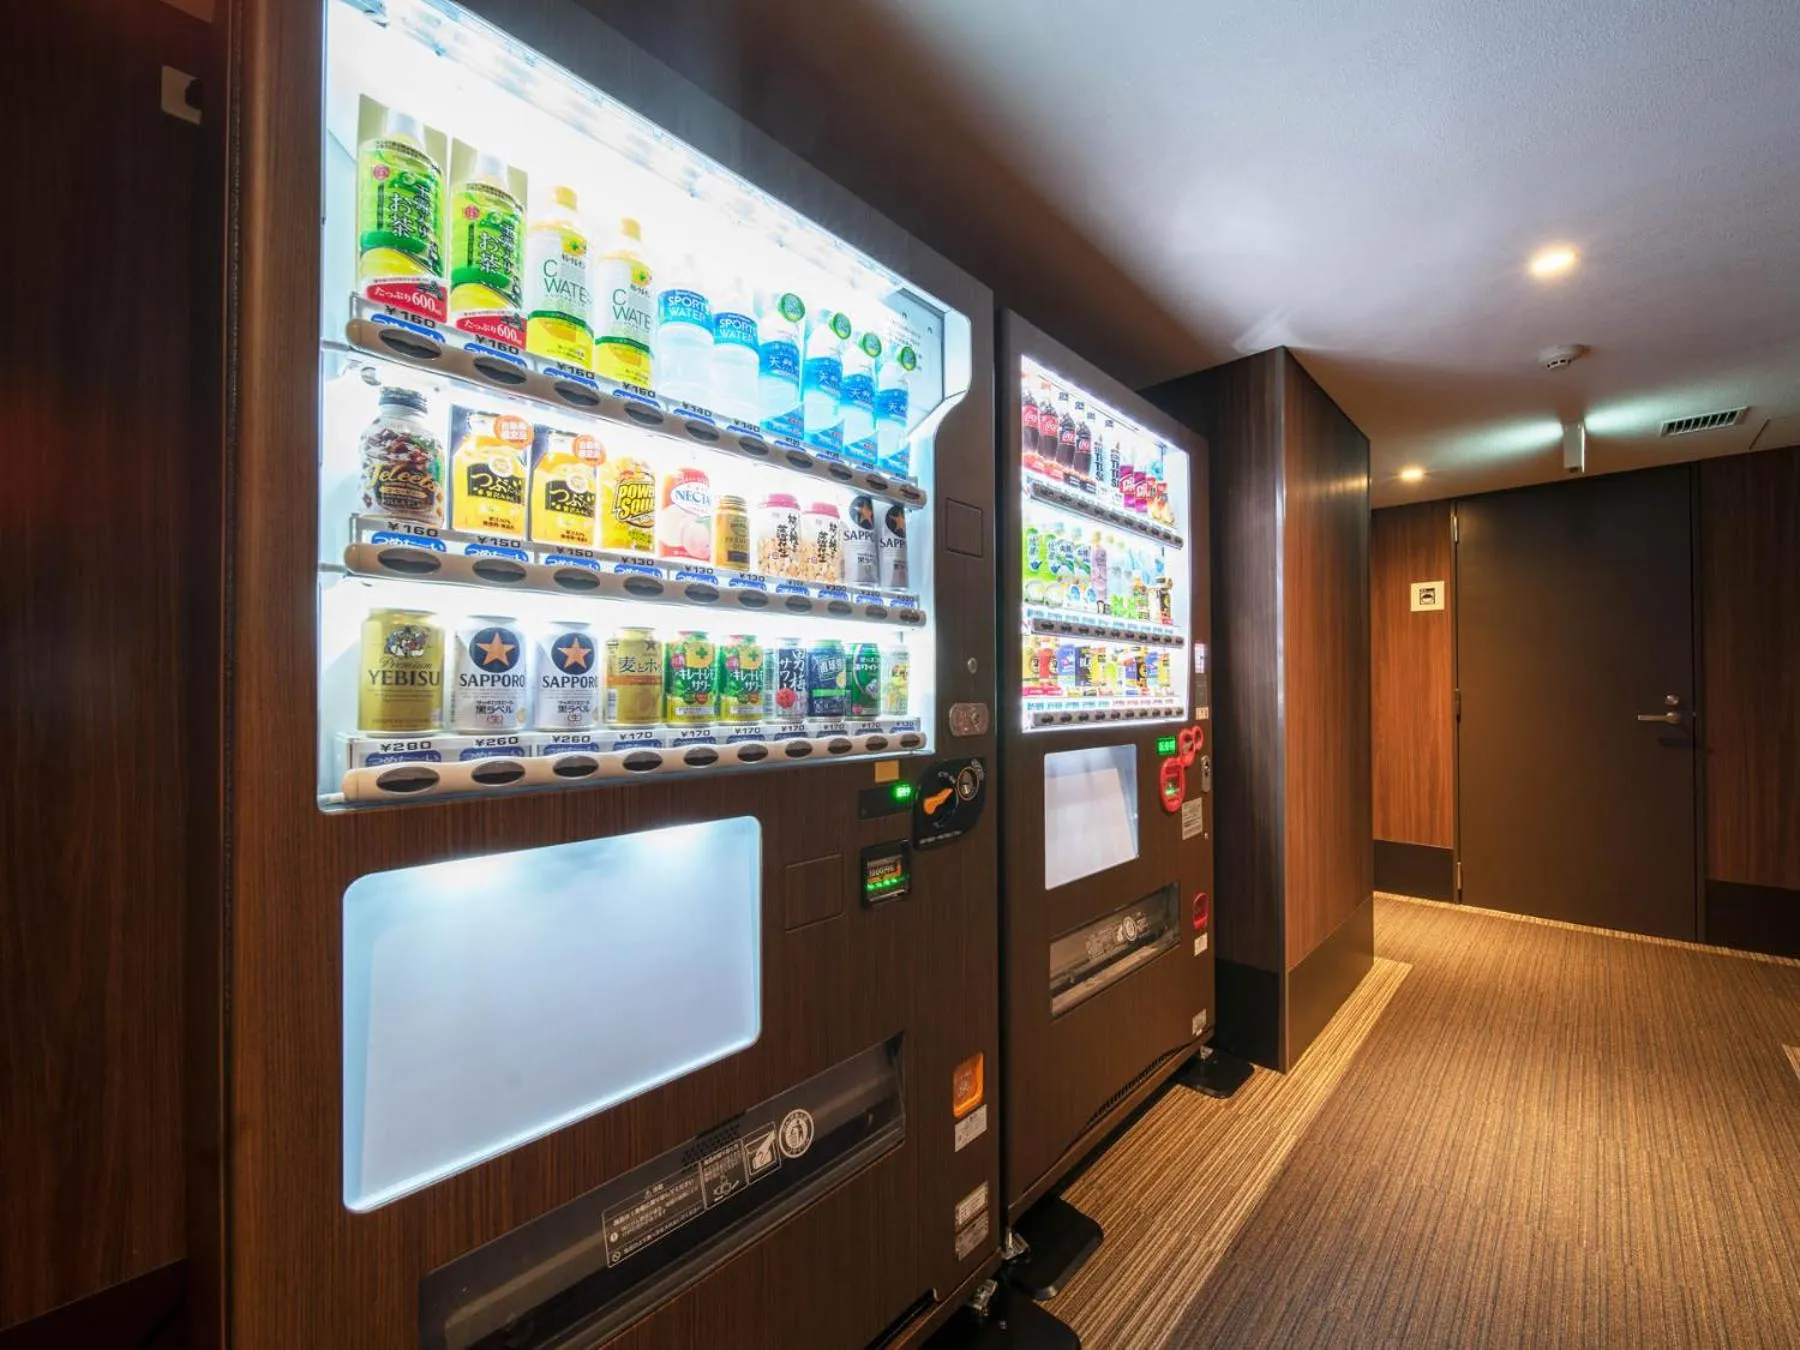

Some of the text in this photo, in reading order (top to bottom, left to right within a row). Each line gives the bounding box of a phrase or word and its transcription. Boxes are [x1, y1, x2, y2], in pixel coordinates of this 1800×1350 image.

[390, 191, 411, 238] お茶
[480, 231, 498, 273] お茶
[543, 259, 557, 278] C
[612, 289, 626, 306] C
[385, 305, 436, 328] ¥160
[612, 305, 651, 330] WATE
[476, 334, 519, 355] ¥160
[557, 361, 595, 379] ¥160
[682, 401, 712, 417] ¥140
[734, 418, 761, 433] ¥140
[388, 521, 439, 537] ¥160
[478, 535, 521, 548] ¥150
[556, 546, 593, 557] ¥150
[622, 557, 655, 566] ¥130
[685, 565, 714, 574] ¥130
[740, 572, 765, 581] ¥130
[368, 669, 441, 687] YEBISU
[459, 673, 525, 687] SAPPORO
[475, 705, 514, 715] 黒ラベル
[558, 705, 590, 714] 黒ラベル
[681, 729, 711, 737] ¥170
[781, 724, 805, 732] ¥170
[475, 736, 519, 747] ¥260
[552, 735, 591, 744] ¥260
[620, 731, 653, 740] ¥170
[380, 741, 432, 752] ¥280
